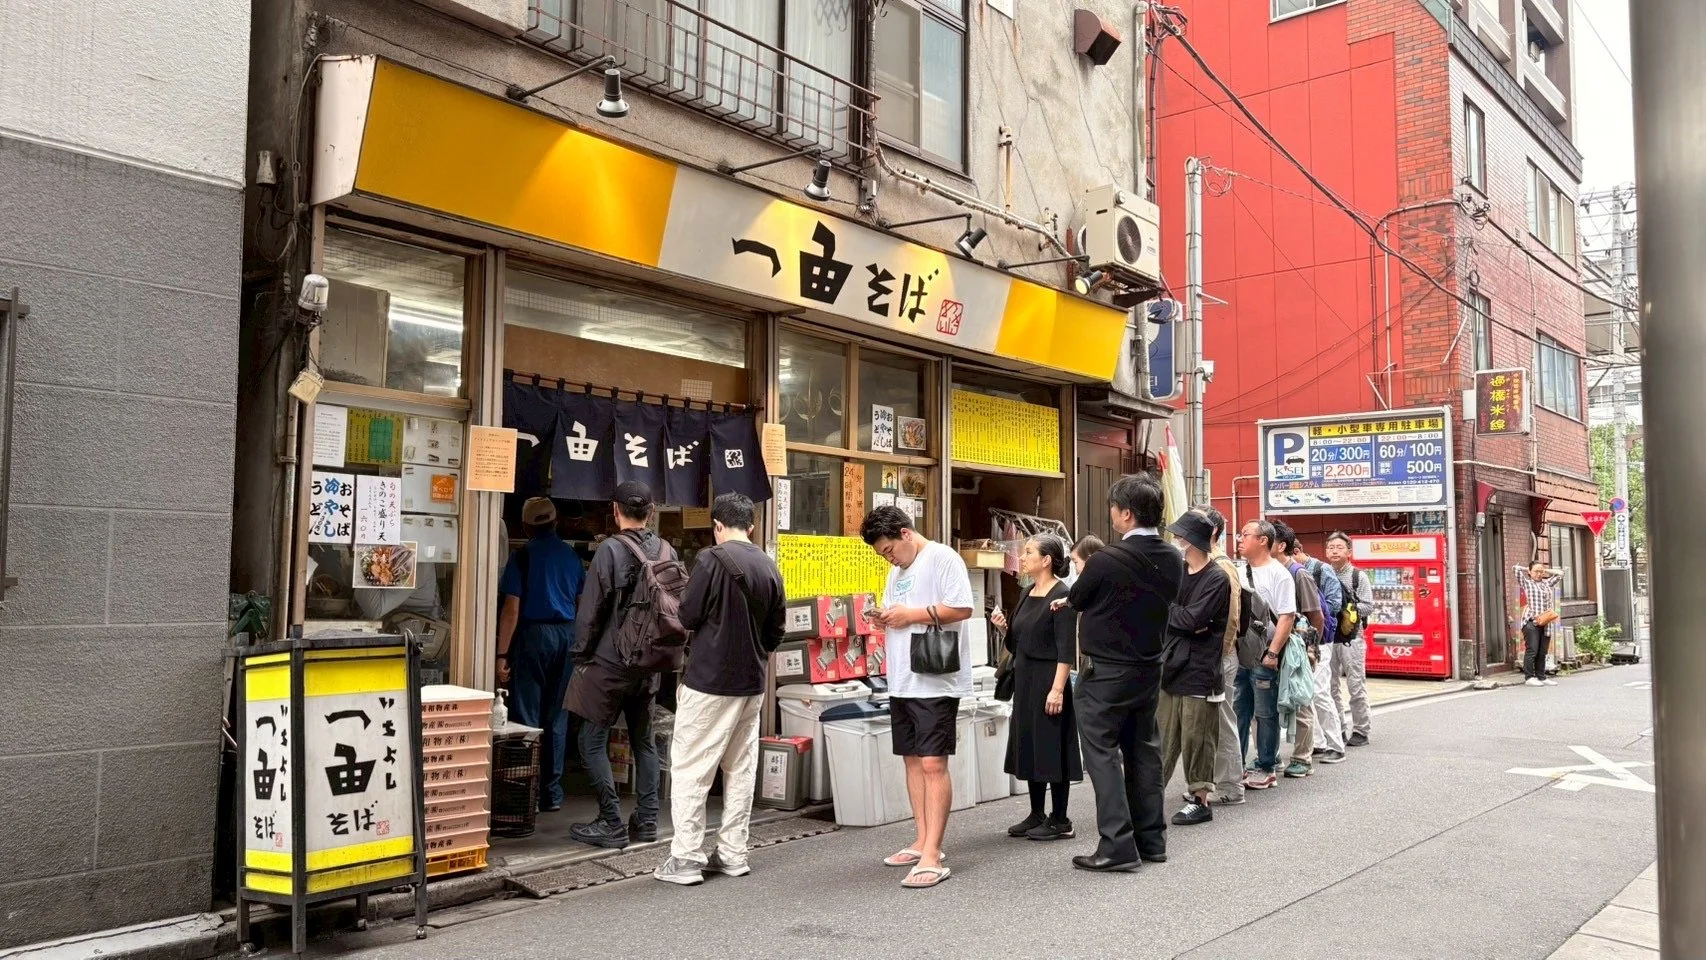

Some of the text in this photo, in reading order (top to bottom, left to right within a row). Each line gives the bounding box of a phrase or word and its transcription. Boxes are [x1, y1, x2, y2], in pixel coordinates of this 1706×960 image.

[1490, 375, 1506, 431] 過橋米線
[1312, 419, 1439, 436] 軽・小型車専用駐車場
[1273, 432, 1305, 466] P
[1311, 446, 1370, 462] 20分/300円
[1325, 463, 1370, 478] 2,200円
[1406, 460, 1442, 474] 500円
[324, 477, 340, 538] 冷やし
[337, 482, 353, 537] おそば
[376, 480, 388, 542] きのこ盛り天
[280, 705, 288, 801] いちよし
[379, 697, 397, 790] いちよし
[253, 810, 277, 839] そば
[326, 800, 378, 835] そば
